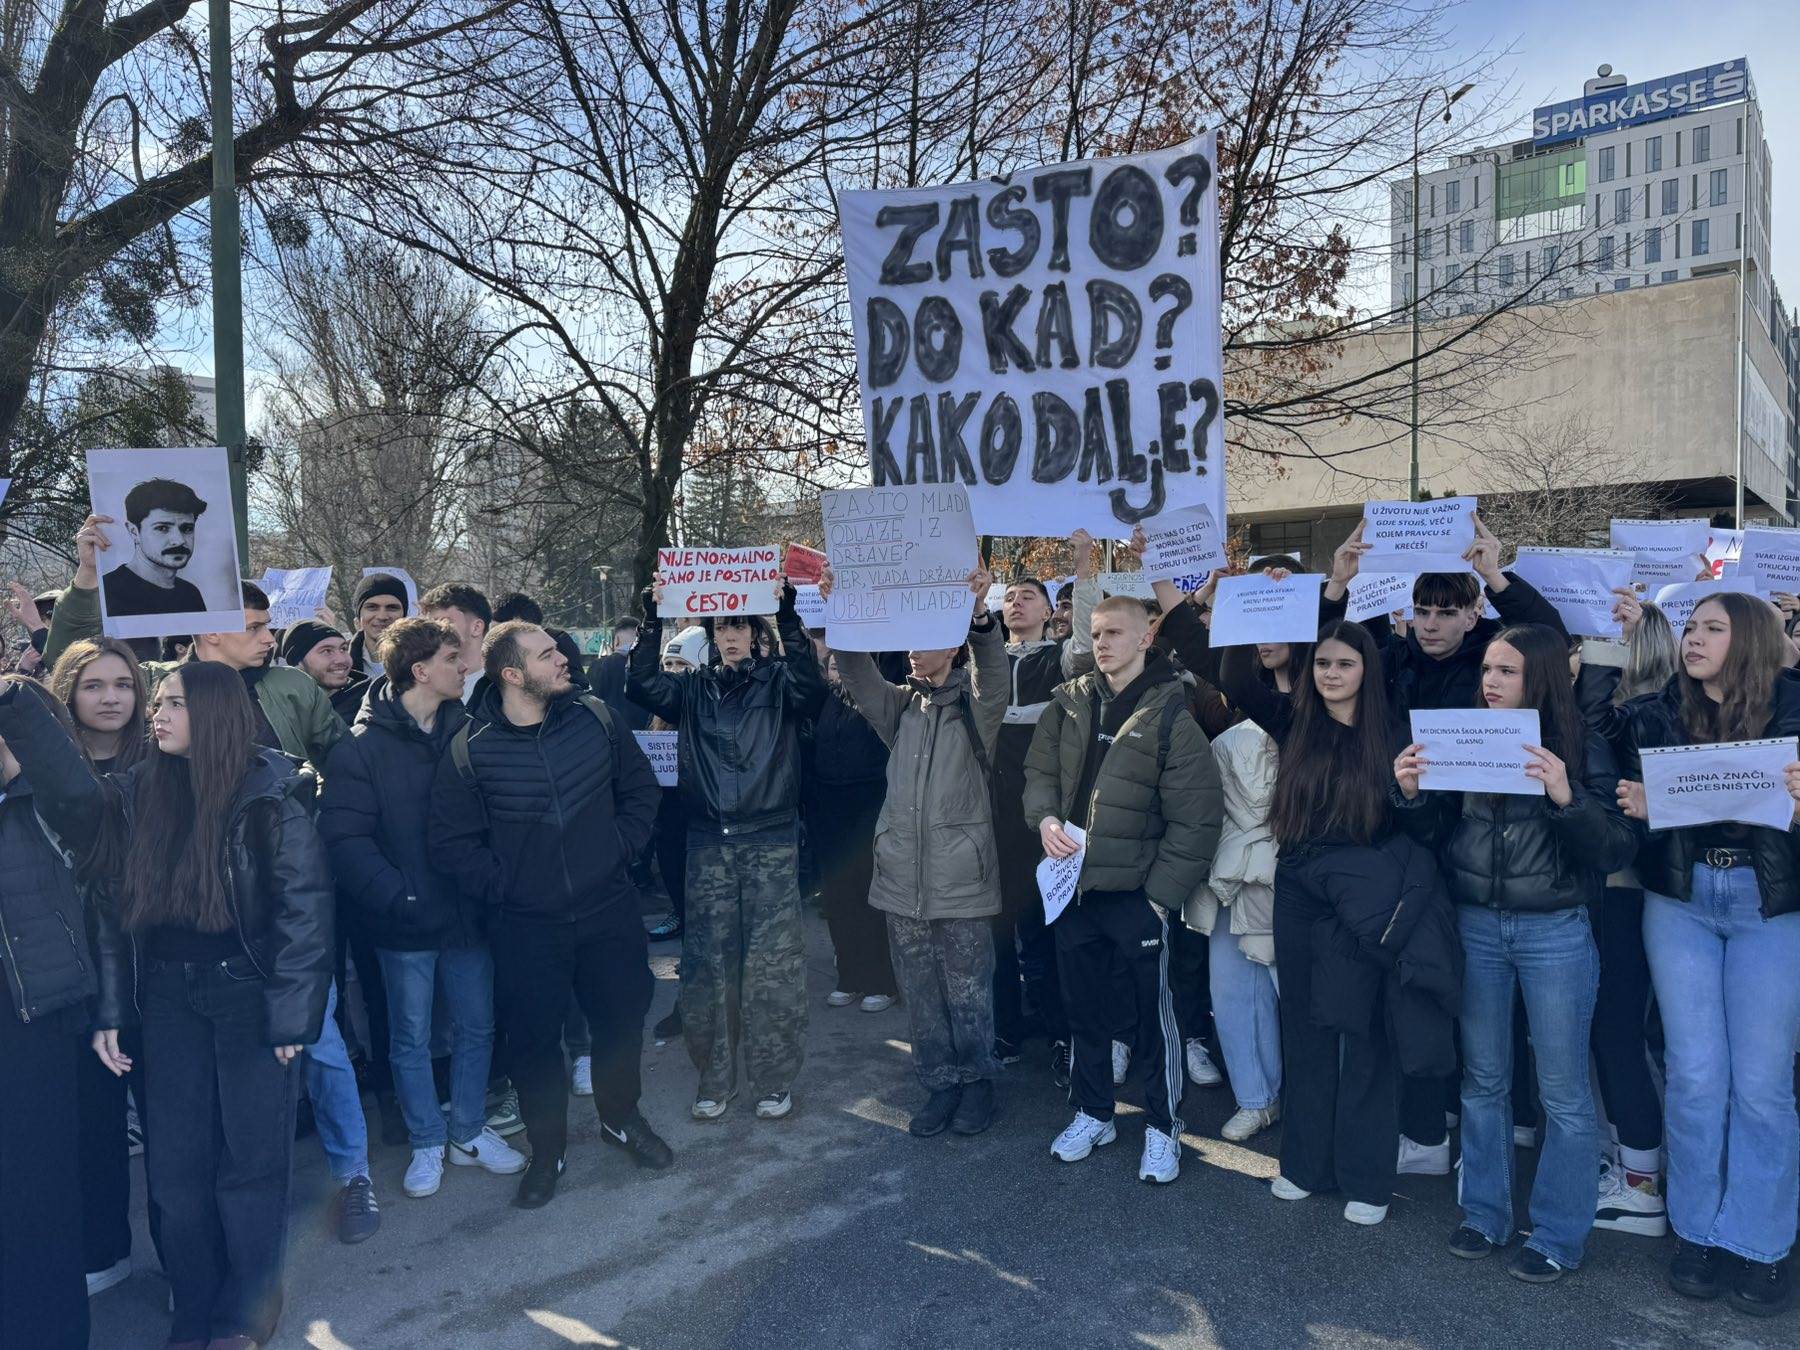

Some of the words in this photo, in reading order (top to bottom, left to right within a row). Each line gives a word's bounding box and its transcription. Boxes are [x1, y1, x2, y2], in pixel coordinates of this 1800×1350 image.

[1533, 79, 1707, 140] SPARKASSE
[876, 153, 1211, 286] ZAŠTO?
[867, 295, 963, 389] DO
[979, 273, 1193, 374] KAD?
[872, 391, 1022, 486] KAKO
[1031, 377, 1219, 524] DALJE?
[1380, 506, 1411, 515] ŽIVOTU
[1413, 508, 1430, 516] NIJE
[1432, 503, 1461, 514] VAŽNO
[919, 517, 942, 537] IZ
[1179, 527, 1185, 535] O
[1186, 534, 1202, 543] SAD
[658, 551, 693, 567] NIJE
[1150, 559, 1181, 571] TEORIJU
[1182, 557, 1188, 565] U
[658, 570, 694, 586] SAMO
[698, 570, 711, 583] JE
[714, 569, 778, 583] POSTALO
[868, 569, 909, 585] VLADA
[1380, 576, 1397, 586] NAS
[1365, 588, 1389, 600] UČITE
[1390, 582, 1407, 592] NAS
[686, 591, 748, 612] ČESTO!
[833, 593, 887, 620] UBIJA
[901, 591, 967, 612] MLADE!
[1461, 727, 1482, 735] ŠKOLA
[1677, 772, 1719, 783] TIŠINA
[1723, 770, 1765, 780] ZNAČI
[1668, 782, 1775, 795] SAUČESNIŠTVO!
[1046, 870, 1073, 902] BORIMO
